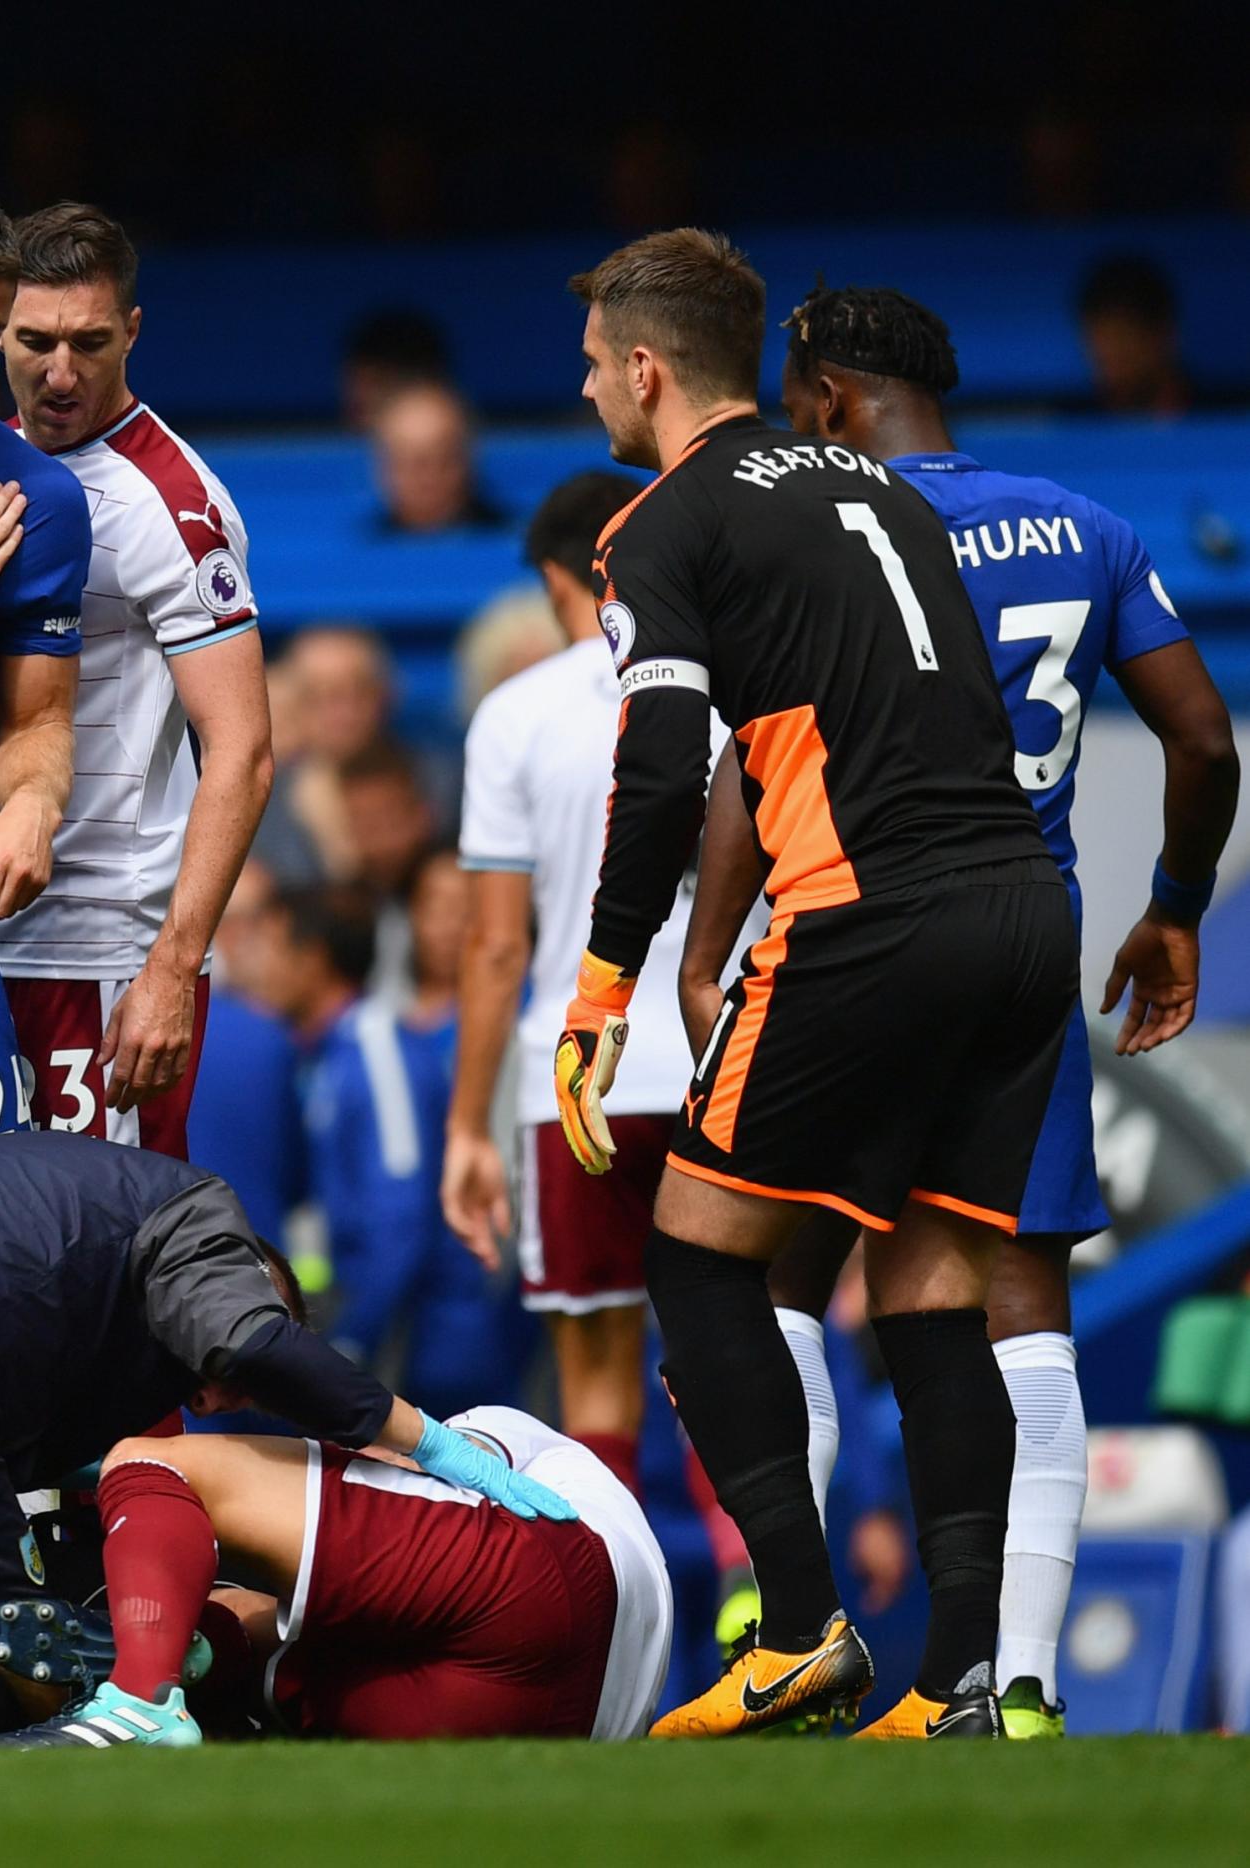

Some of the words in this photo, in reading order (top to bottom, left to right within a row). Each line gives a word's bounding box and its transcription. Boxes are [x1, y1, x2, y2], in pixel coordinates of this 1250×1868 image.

[733, 445, 890, 490] HEATON
[835, 503, 940, 671] 1
[998, 599, 1092, 791] 3
